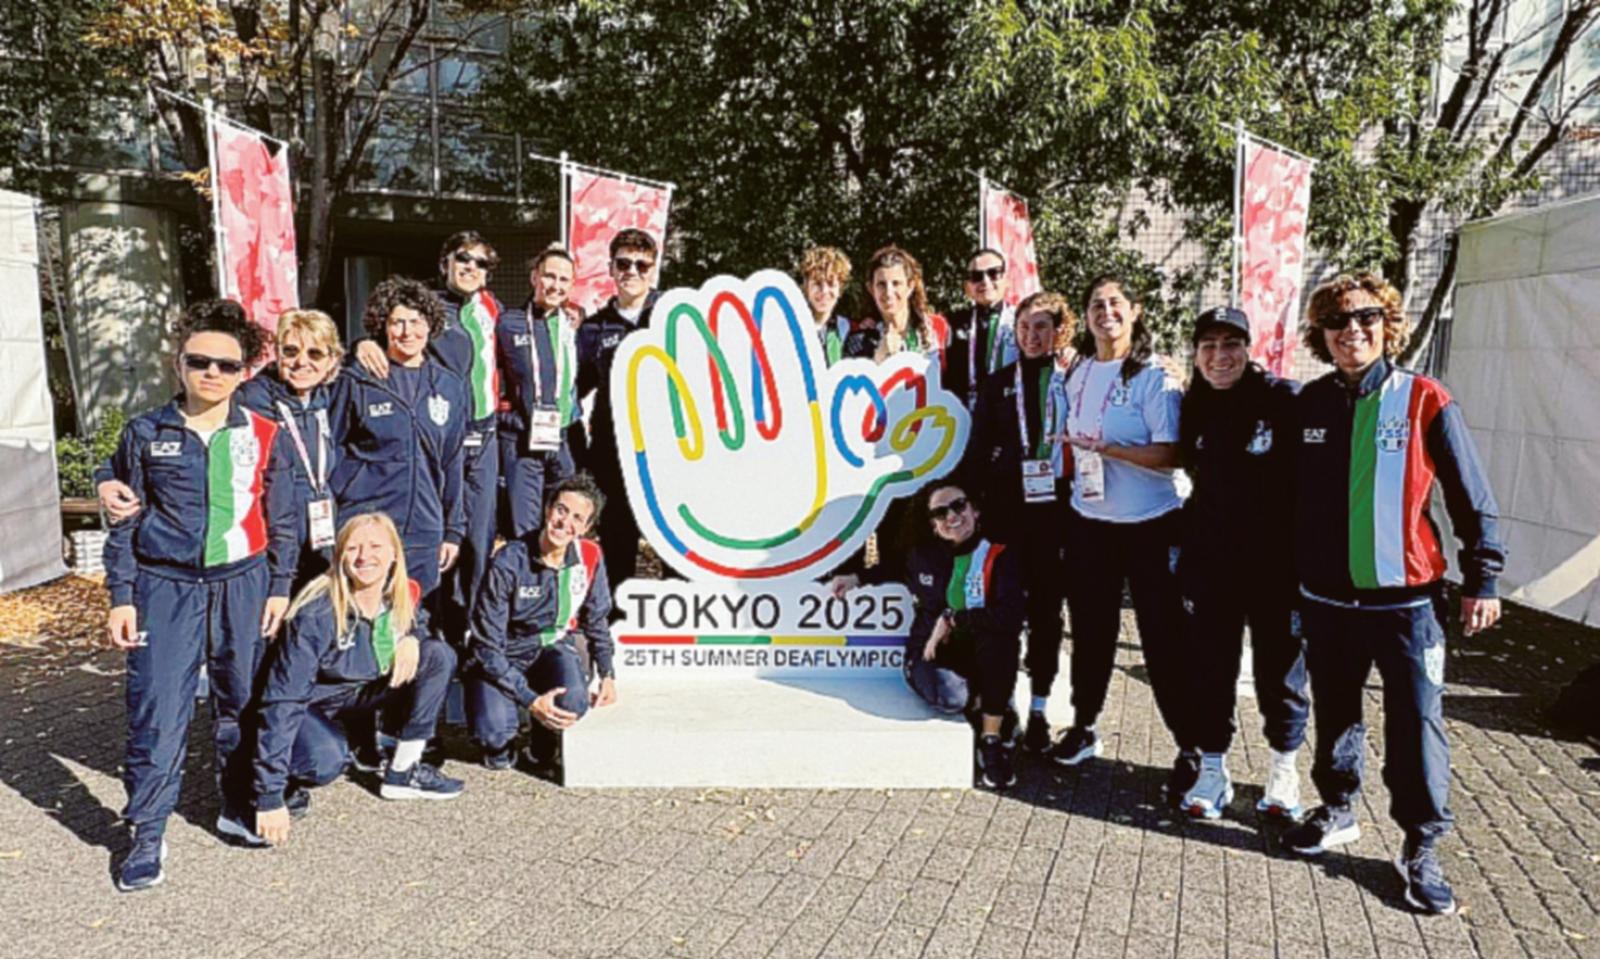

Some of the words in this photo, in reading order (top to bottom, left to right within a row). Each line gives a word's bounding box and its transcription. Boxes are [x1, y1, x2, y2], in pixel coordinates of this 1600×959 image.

[628, 594, 780, 630] TOKYO
[798, 594, 904, 630] 2025
[624, 649, 673, 667] 25TH
[680, 649, 768, 667] SUMMER
[774, 649, 903, 668] DEAFLYMPIC
